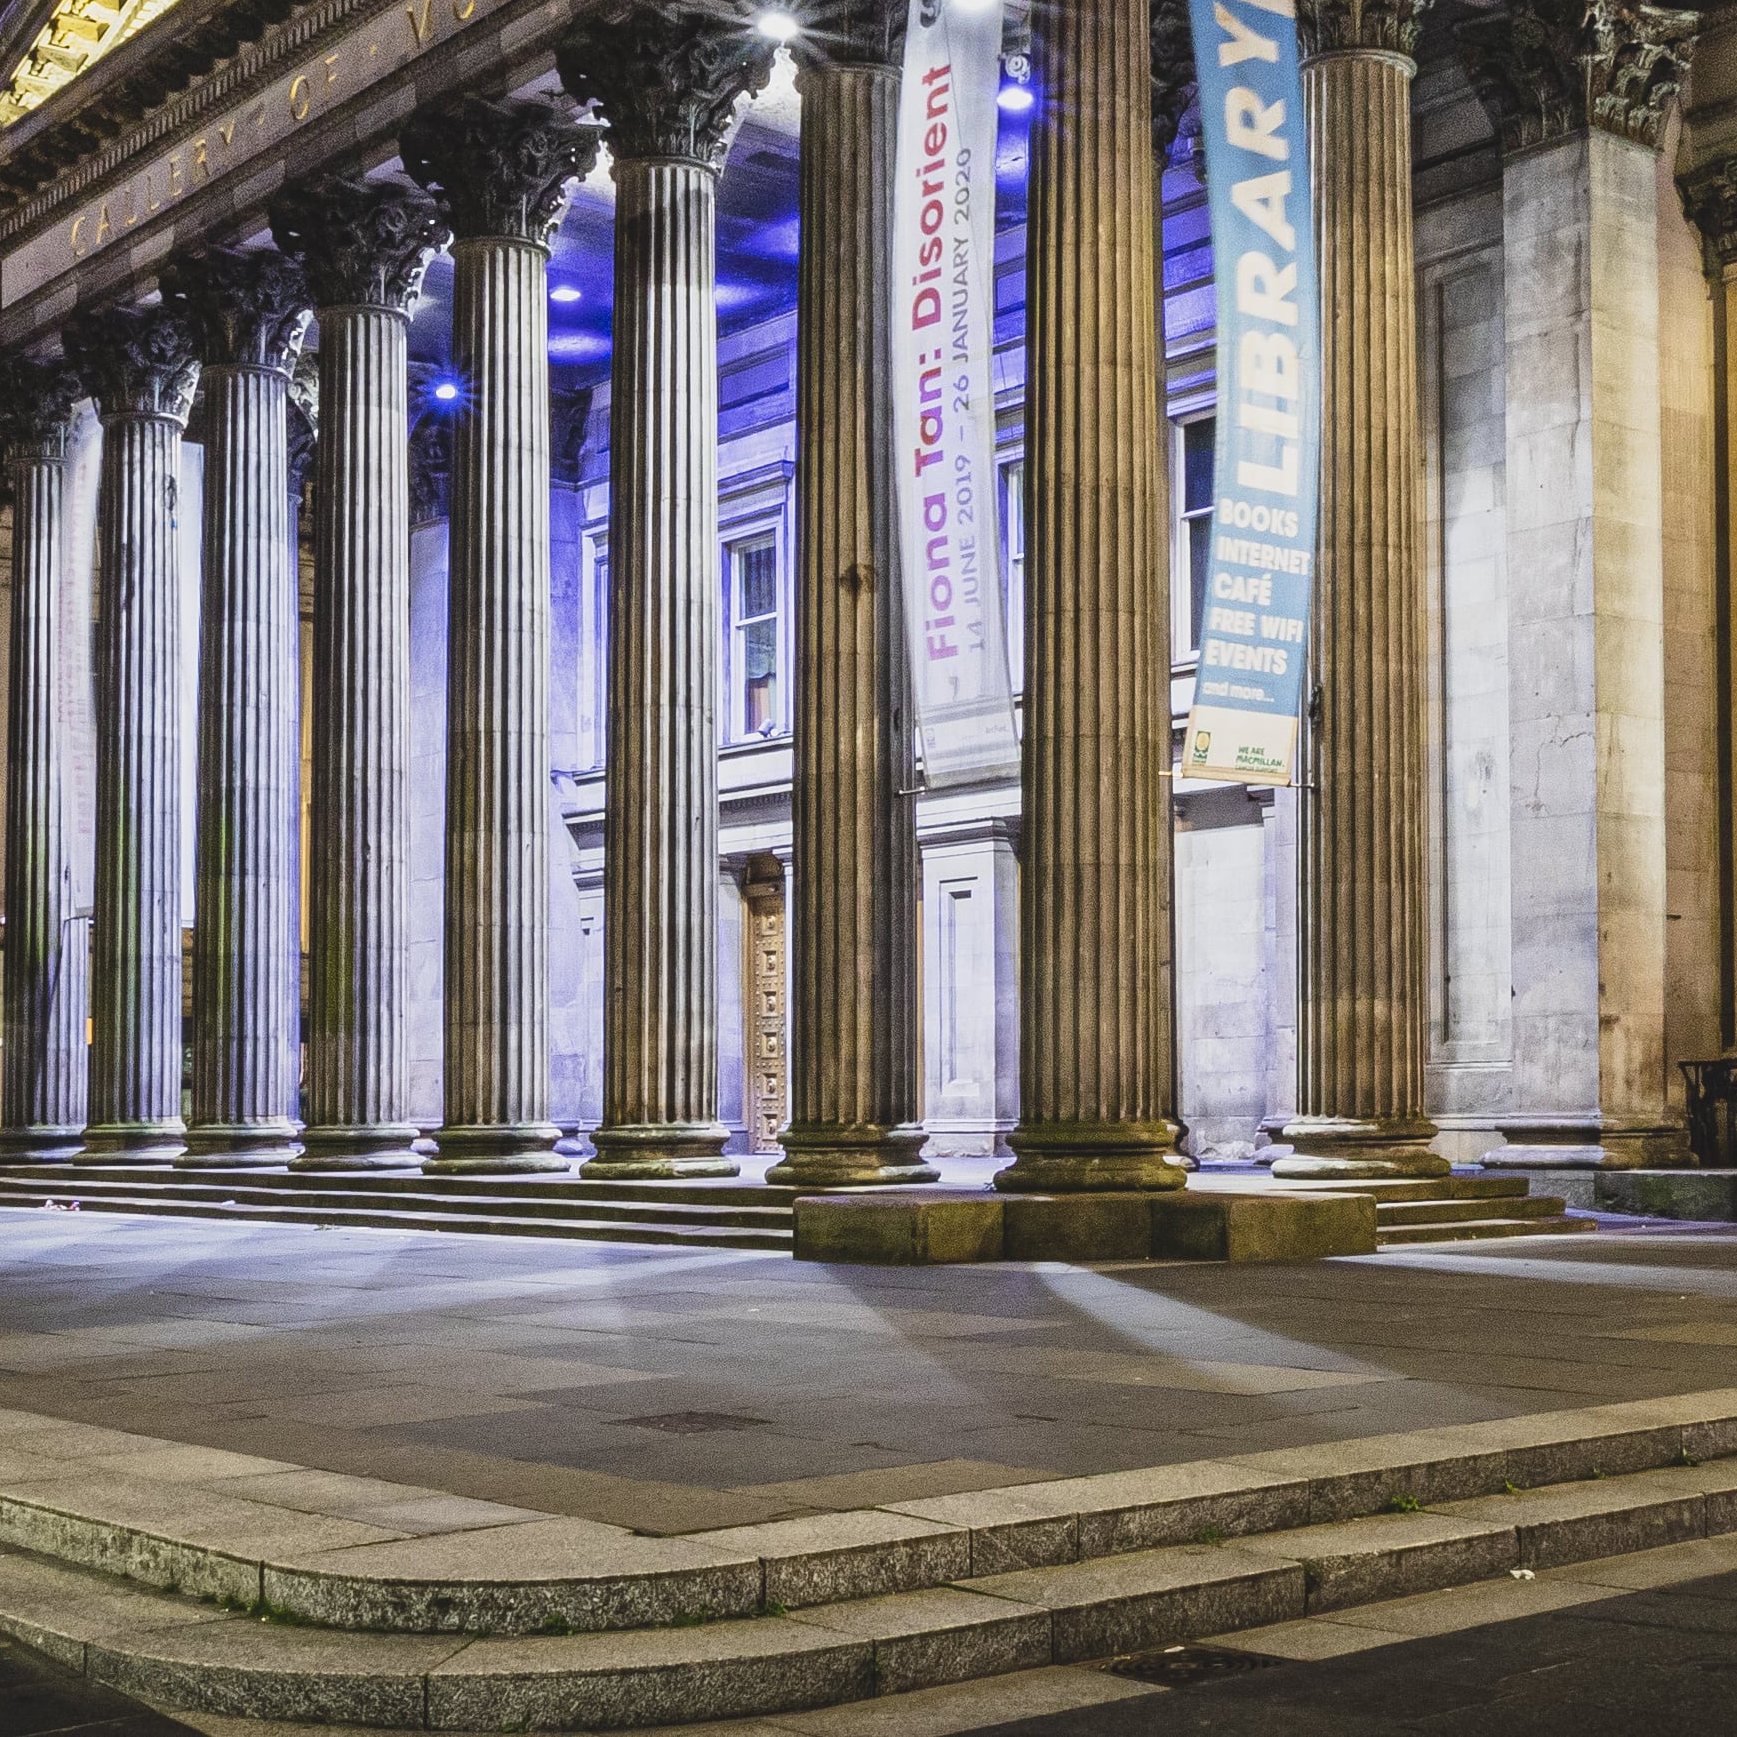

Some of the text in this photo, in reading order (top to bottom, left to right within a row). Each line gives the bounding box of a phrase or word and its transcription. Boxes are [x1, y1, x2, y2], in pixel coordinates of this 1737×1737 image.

[289, 53, 339, 121] OF
[911, 63, 952, 332] Disorient
[953, 148, 972, 226] 2020
[1213, 1, 1299, 497] LIBRARY
[952, 236, 969, 363] JANUARY
[914, 348, 944, 478] Tan:
[953, 374, 970, 414] 26
[955, 454, 975, 526] 2019
[1218, 498, 1299, 538] BOOKS
[923, 492, 960, 661] Fiona
[959, 534, 979, 605] JUNE
[1216, 536, 1311, 576] INTERNET
[1214, 572, 1273, 606] CAFÉ
[968, 620, 985, 652] 14
[1208, 606, 1304, 643] FREE WIFI
[1203, 638, 1288, 675] EVENTS
[1202, 681, 1228, 697] and
[1238, 746, 1265, 756] WE ARE
